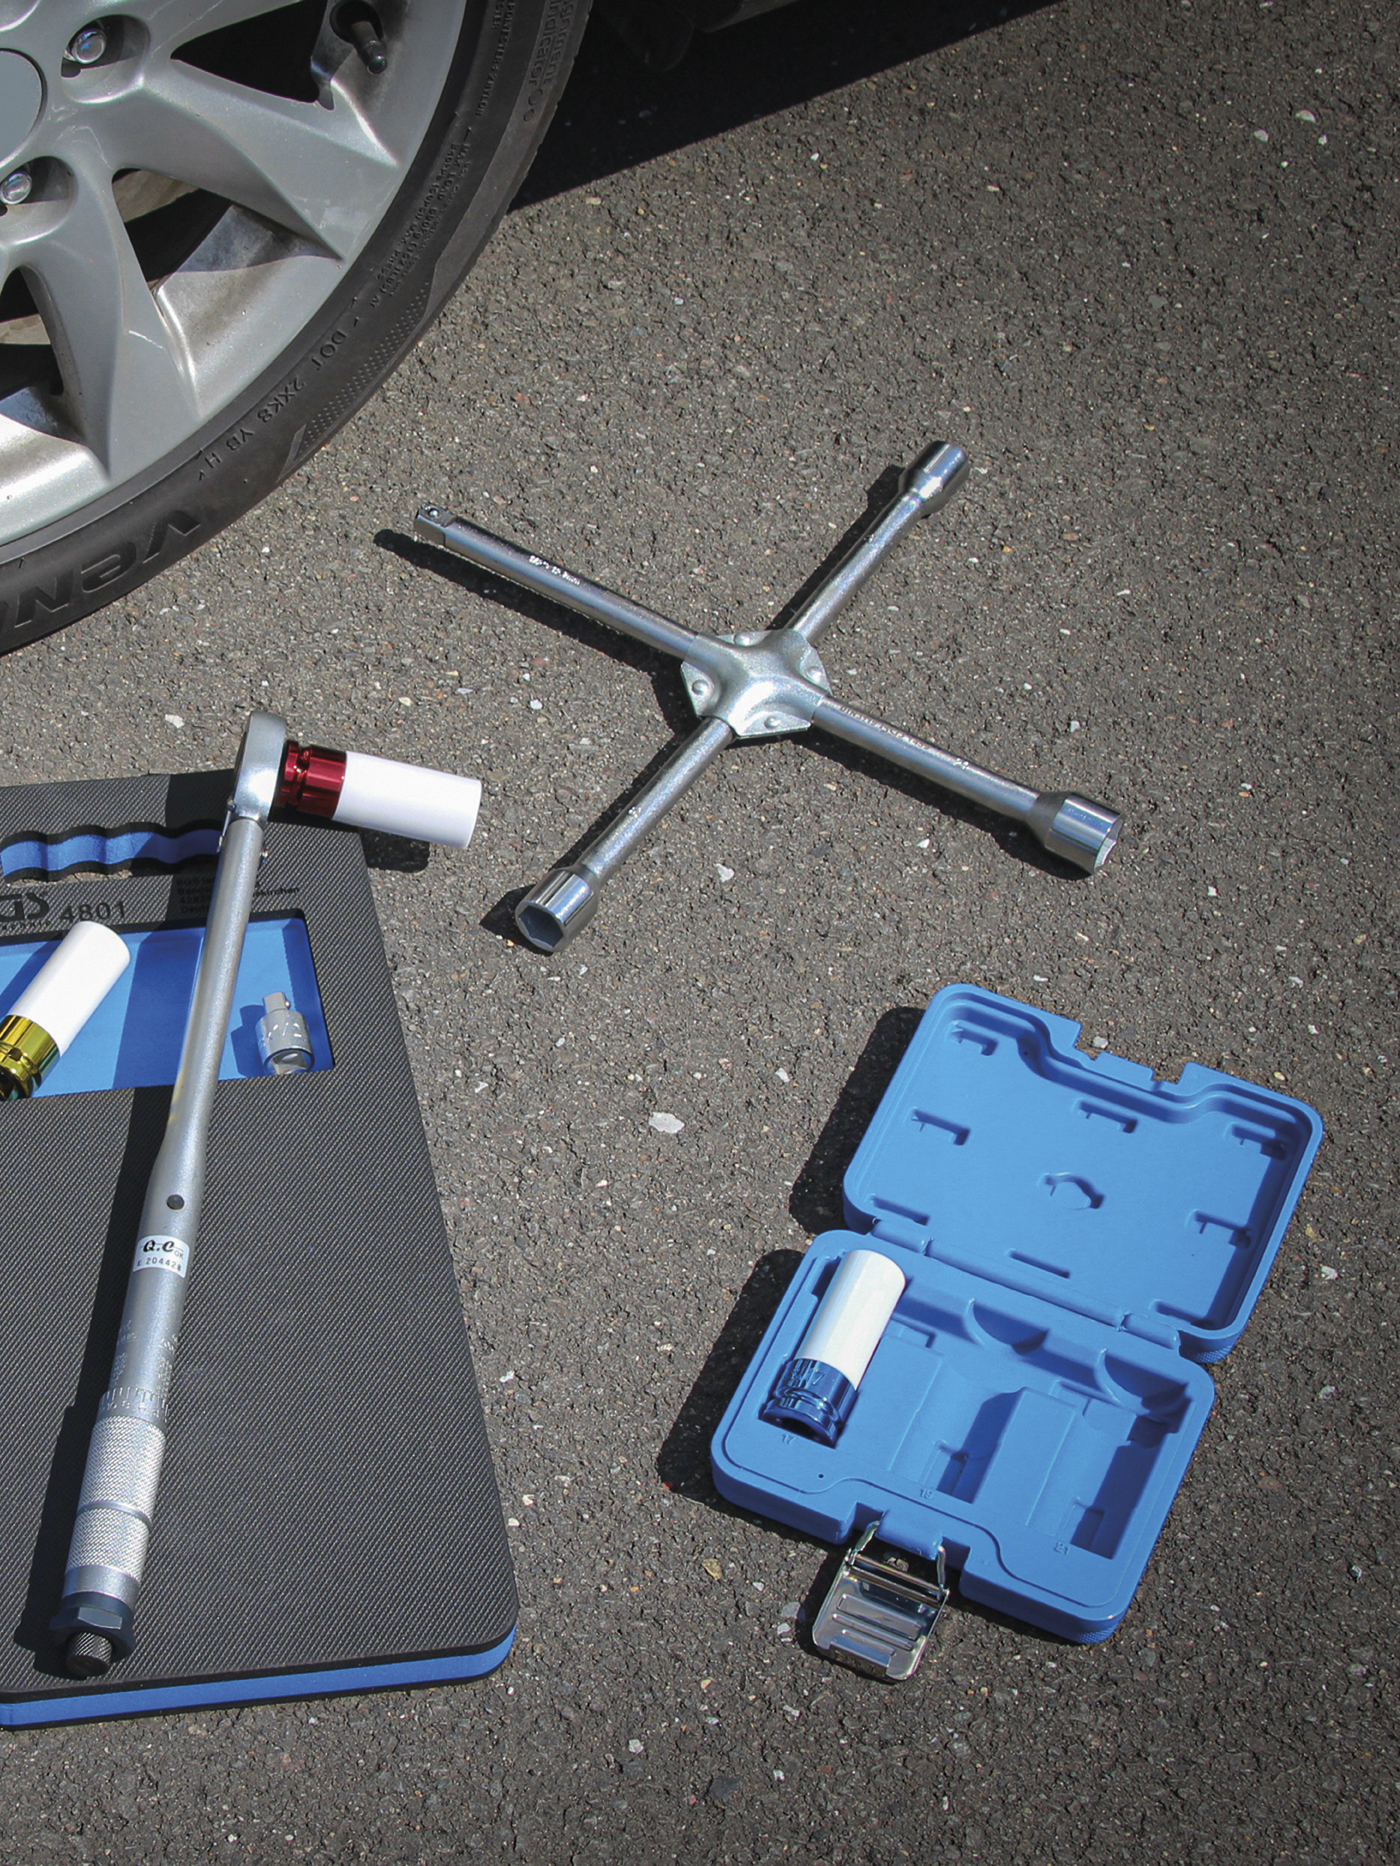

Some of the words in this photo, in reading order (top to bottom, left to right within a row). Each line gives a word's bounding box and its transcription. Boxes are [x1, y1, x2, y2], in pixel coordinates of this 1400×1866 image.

[310, 330, 347, 372] DOT
[256, 377, 305, 423] 2XK8
[225, 428, 254, 451] YB
[204, 452, 221, 469] H
[59, 901, 125, 923] 4801
